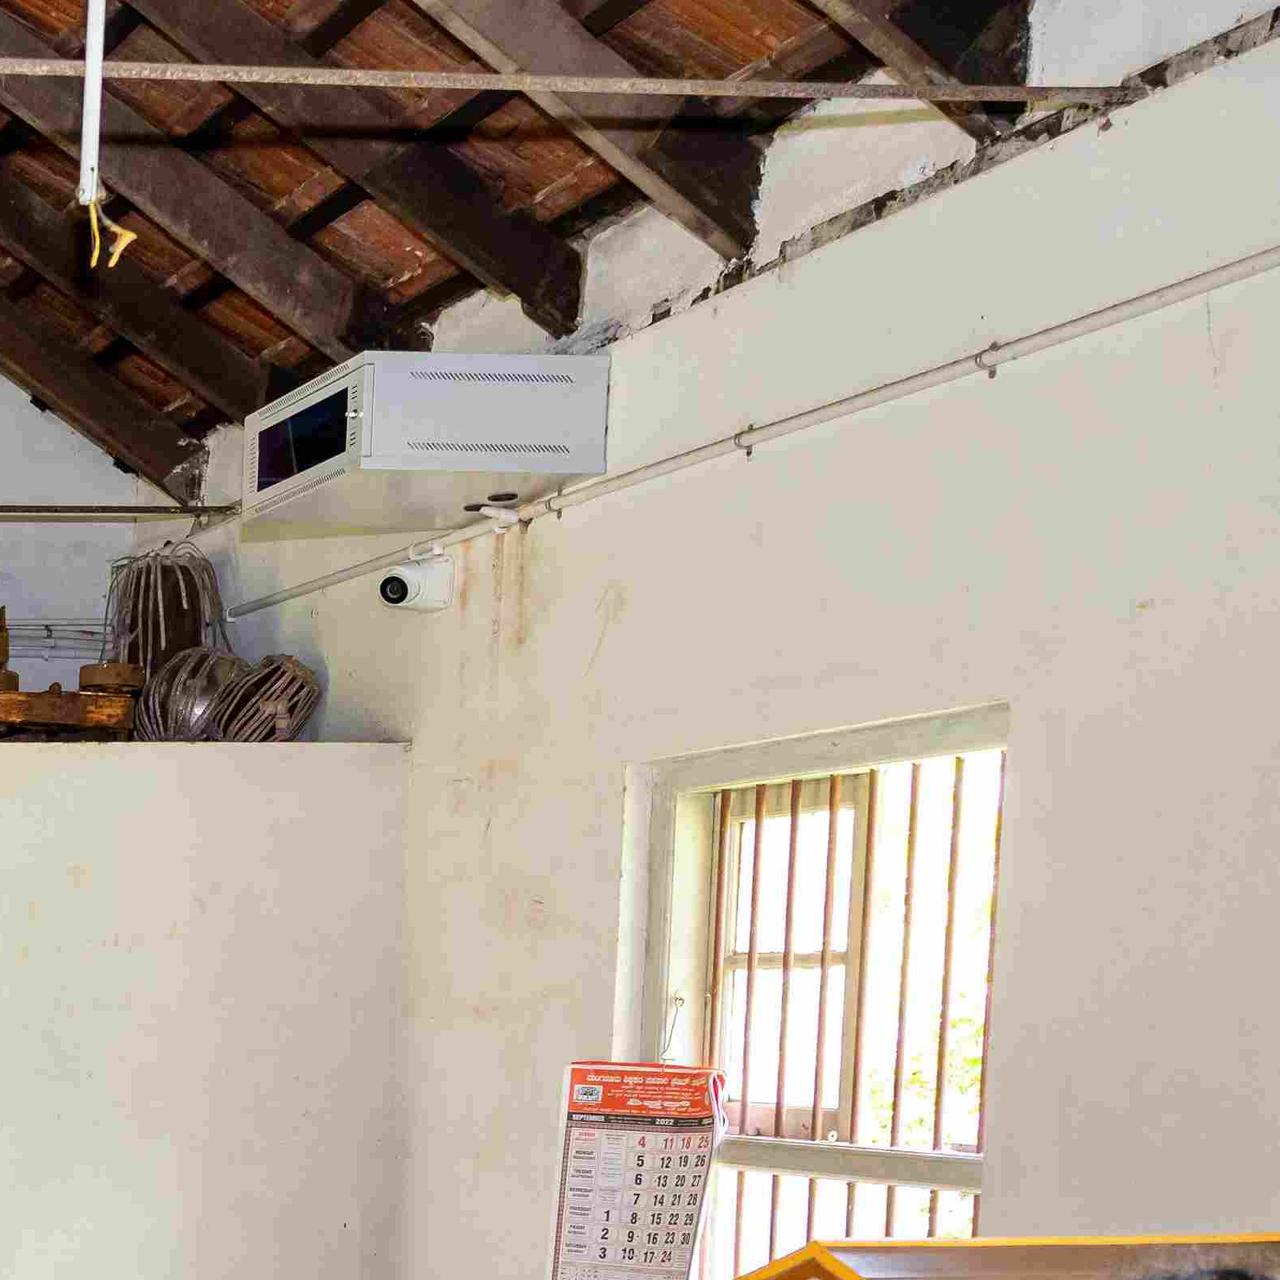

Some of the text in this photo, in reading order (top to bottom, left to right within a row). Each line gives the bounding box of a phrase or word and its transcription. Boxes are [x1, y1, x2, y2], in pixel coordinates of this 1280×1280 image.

[638, 1136, 709, 1149] 4 11 18 25
[637, 1155, 705, 1168] 5 12 19 26
[635, 1174, 701, 1187] 6 13 20 27
[634, 1193, 697, 1206] 7 14 21 28
[604, 1210, 610, 1222] 1
[630, 1212, 638, 1224] 8
[650, 1213, 661, 1225] 15
[668, 1213, 679, 1225] 22
[684, 1213, 693, 1225] 29
[601, 1228, 690, 1244] 2 9 16 23 30
[599, 1248, 606, 1259] 3
[622, 1247, 634, 1259] 10
[644, 1252, 654, 1263] 17
[661, 1251, 672, 1263] 24
